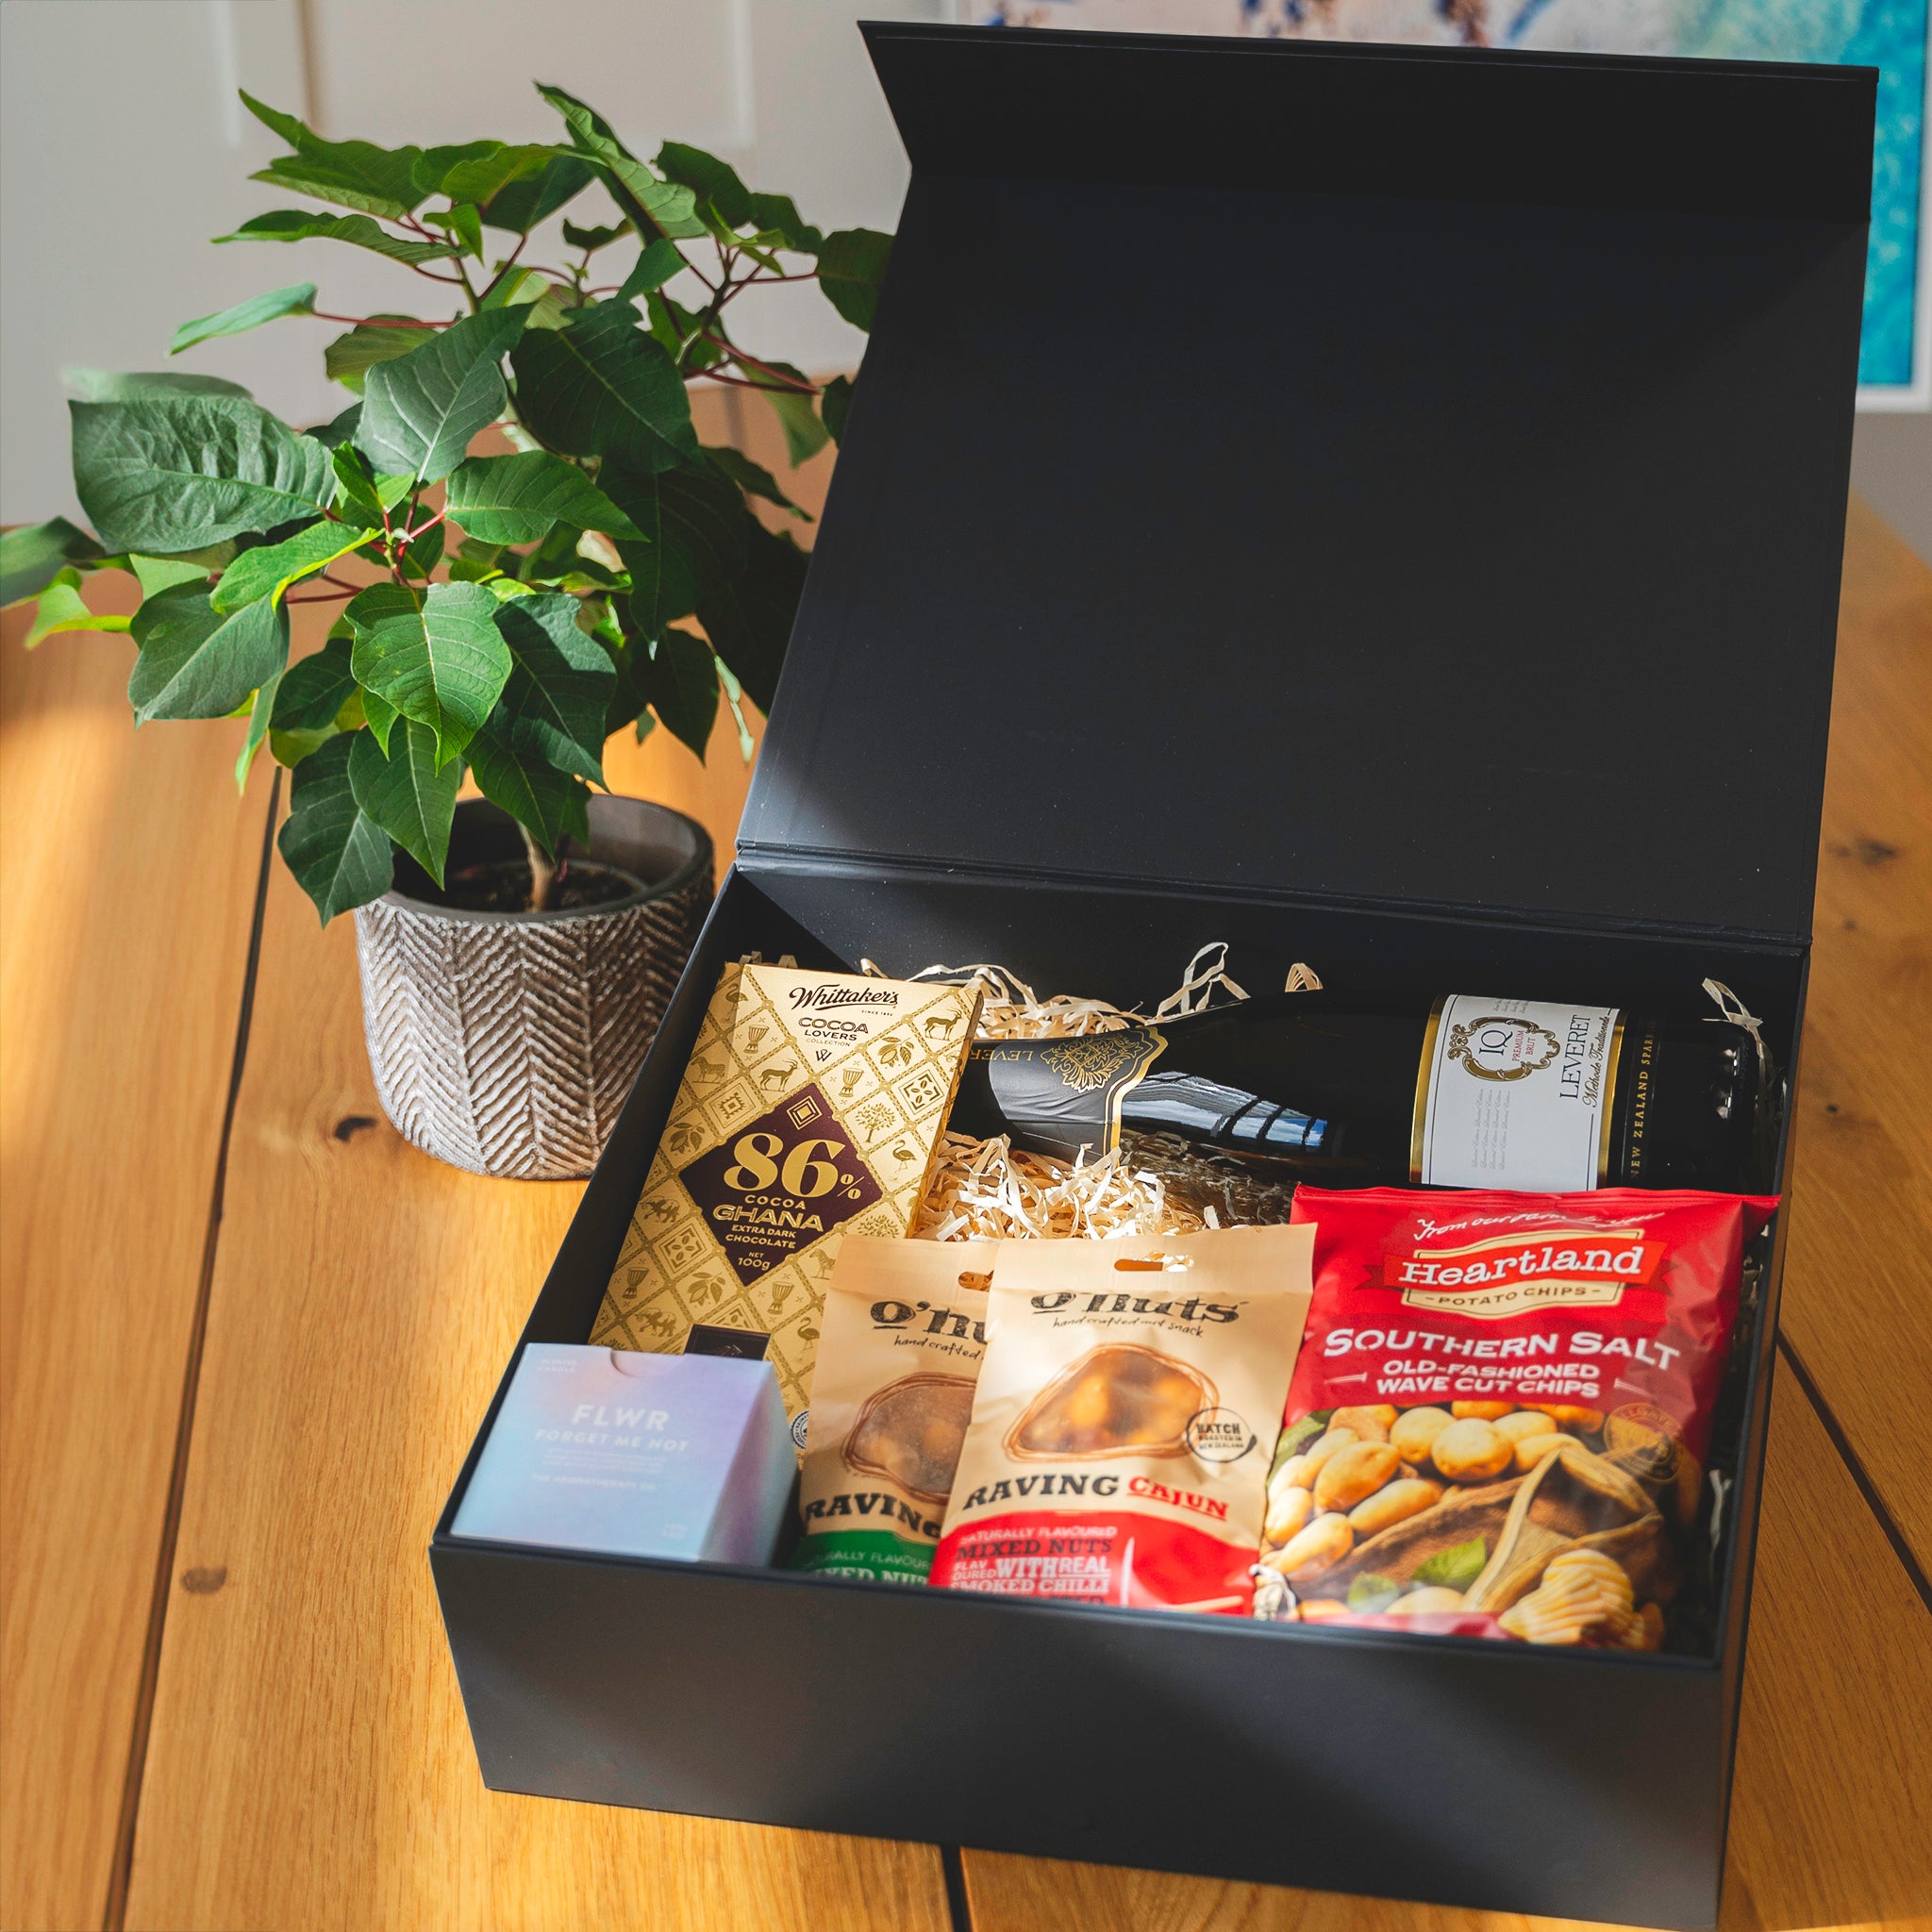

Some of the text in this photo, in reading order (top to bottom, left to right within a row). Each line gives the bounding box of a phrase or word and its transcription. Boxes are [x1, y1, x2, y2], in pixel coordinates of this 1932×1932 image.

[789, 984, 899, 1009] Whittaker's
[798, 1017, 869, 1034] COCOA
[804, 1029, 858, 1041] LOVERS
[805, 1038, 852, 1047] COLLECTION
[1478, 1029, 1513, 1056] IQ
[1511, 1030, 1524, 1062] PREMIUM
[1525, 1037, 1536, 1056] BRUT
[1559, 1014, 1591, 1100] LEVERET
[1633, 1071, 1649, 1139] ZEALAND
[724, 1132, 865, 1200] 86%
[1630, 1146, 1642, 1178] NEW
[744, 1194, 807, 1210] COCOA
[712, 1204, 824, 1232] GHANA
[724, 1234, 797, 1249] CHOCOLATE
[731, 1224, 797, 1239] EXTRA DARK
[737, 1257, 772, 1271] 100g
[1398, 1246, 1645, 1287] Heartland
[1439, 1287, 1587, 1307] POTATO CHIPS
[893, 1334, 929, 1347] hand
[1168, 1323, 1204, 1338] snack
[1323, 1327, 1681, 1371] SOUTHERN SALT
[1381, 1358, 1601, 1381] OLD-FASHIONED
[1375, 1375, 1601, 1398] WAVE CUT CHIPS
[570, 1403, 670, 1432] FLWR
[1196, 1422, 1241, 1434] BATCH
[534, 1428, 691, 1453] FORGET ME NOT
[962, 1474, 1230, 1519] RAVING CAJUN
[805, 1491, 942, 1540] RAVING
[1039, 1524, 1118, 1539] FLAVOURED
[956, 1539, 1113, 1560] MIXED NUTS
[995, 1556, 1110, 1579] WITH REAL
[1039, 1577, 1110, 1594] CHILLI
